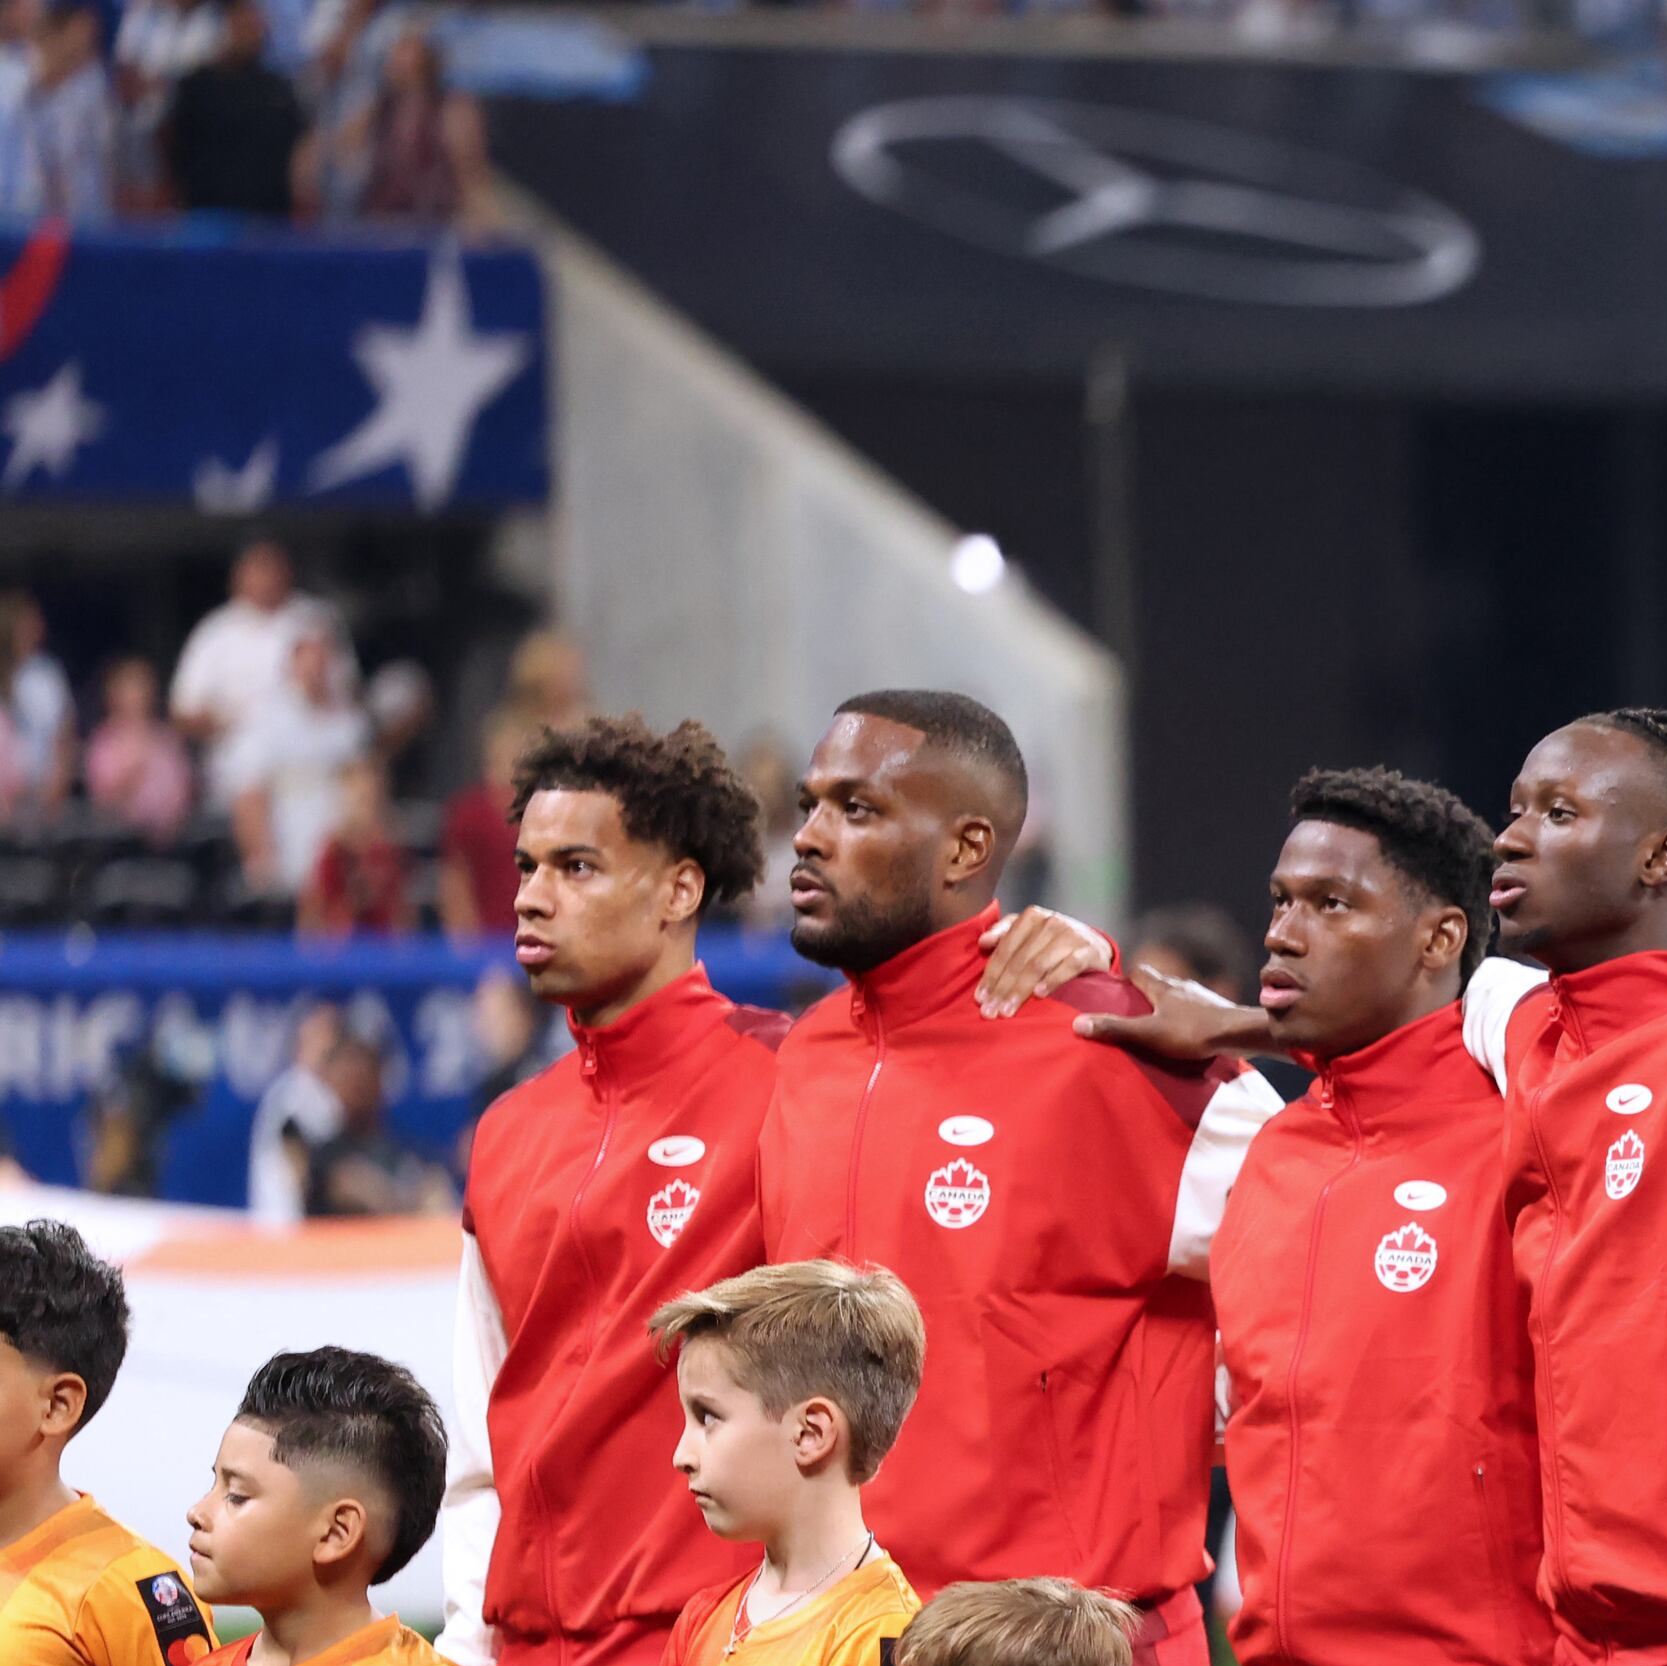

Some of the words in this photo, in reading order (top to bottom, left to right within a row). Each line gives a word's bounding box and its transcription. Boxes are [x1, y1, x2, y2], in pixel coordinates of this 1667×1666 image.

[1607, 1162, 1640, 1171] CANADA
[929, 1190, 985, 1200] CANADA
[1378, 1254, 1431, 1264] CANADA
